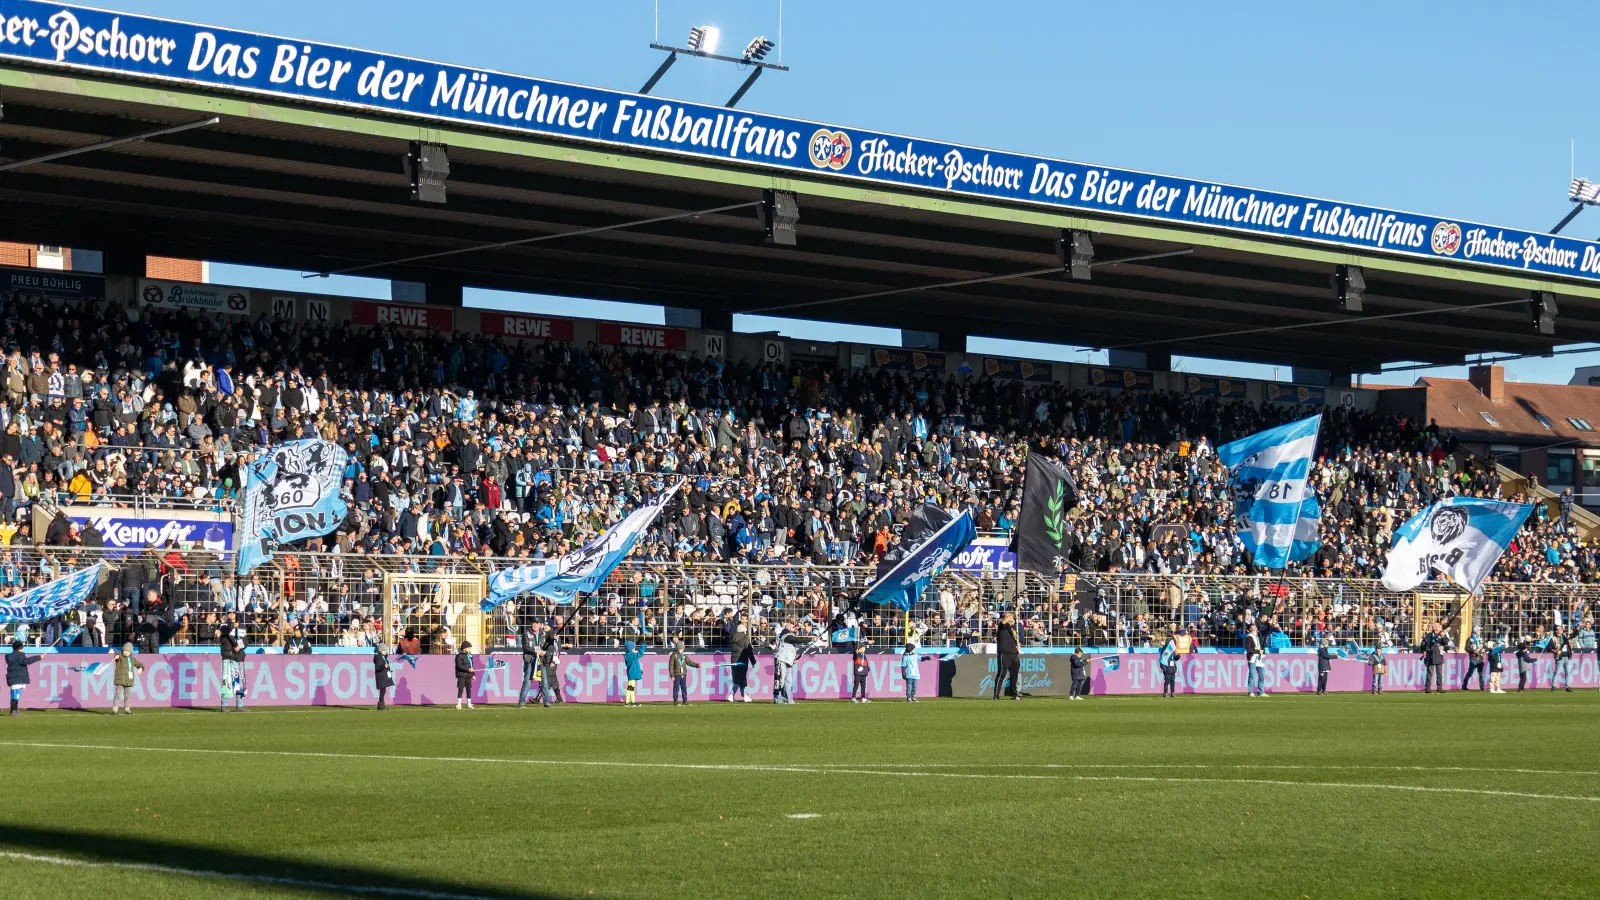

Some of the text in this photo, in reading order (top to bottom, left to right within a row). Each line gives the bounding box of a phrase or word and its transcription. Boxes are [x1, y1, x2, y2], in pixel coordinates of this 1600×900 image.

[188, 32, 260, 78] Das
[270, 45, 351, 90] Bier
[358, 61, 424, 102] der
[430, 71, 607, 128] Münchner
[613, 100, 800, 158] Fußballfans
[858, 138, 1426, 246] Hacker-Pschorr Das Bier der Münchner Fußballfans
[1464, 229, 1578, 269] Hacker-Pschorr
[11, 274, 39, 286] PREU
[279, 300, 293, 318] M
[310, 302, 322, 320] N
[377, 305, 427, 327] REWE
[504, 317, 551, 337] REWE
[621, 327, 664, 347] REWE
